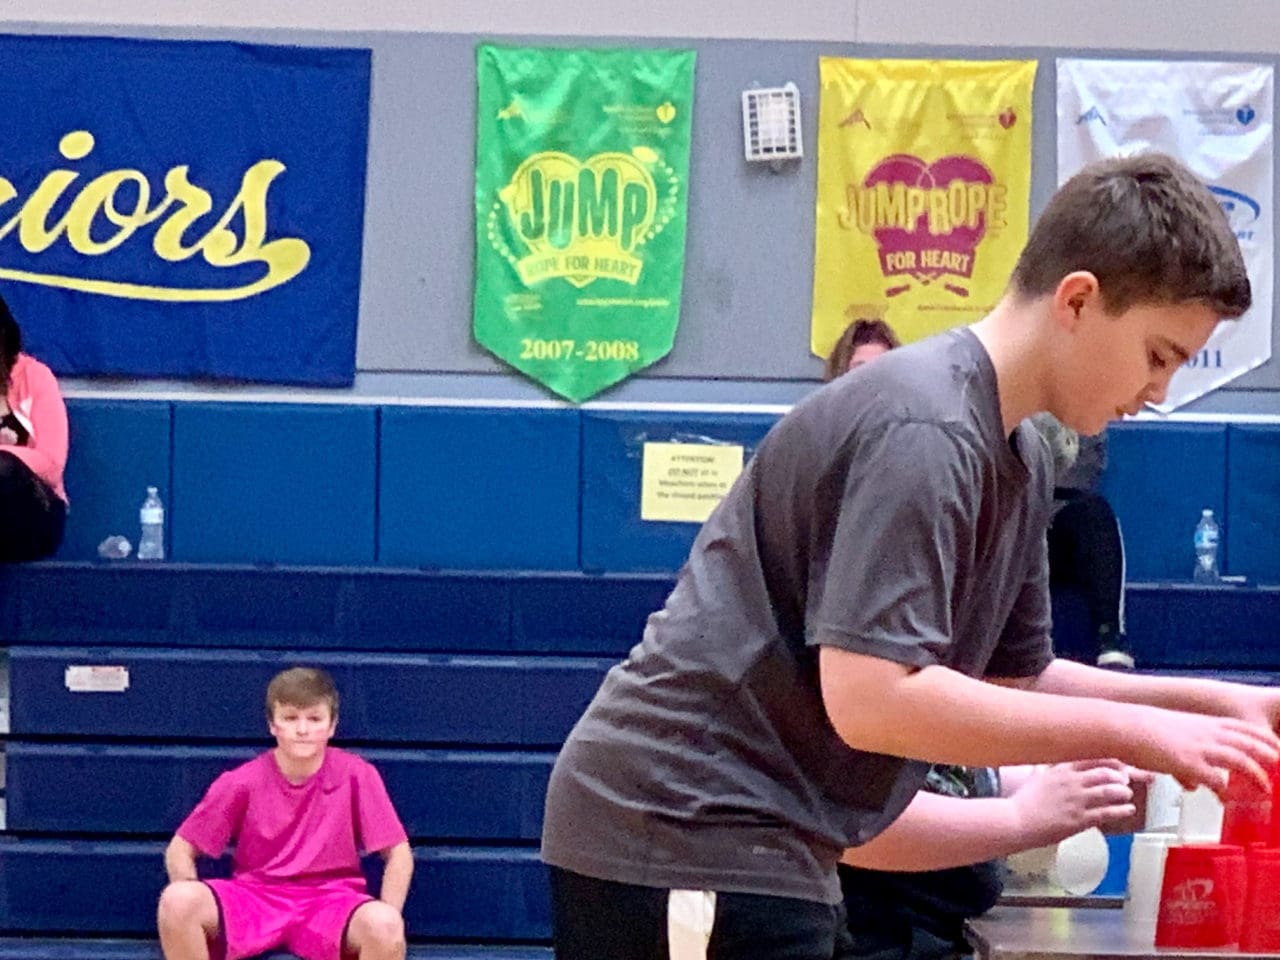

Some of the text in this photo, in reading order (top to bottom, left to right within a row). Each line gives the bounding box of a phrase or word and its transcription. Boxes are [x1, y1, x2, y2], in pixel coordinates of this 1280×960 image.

[519, 167, 649, 250] JUMP
[565, 255, 588, 270] FOR
[594, 258, 638, 276] HEART
[885, 250, 970, 272] FOR HEART
[520, 338, 639, 361] 2007-2008
